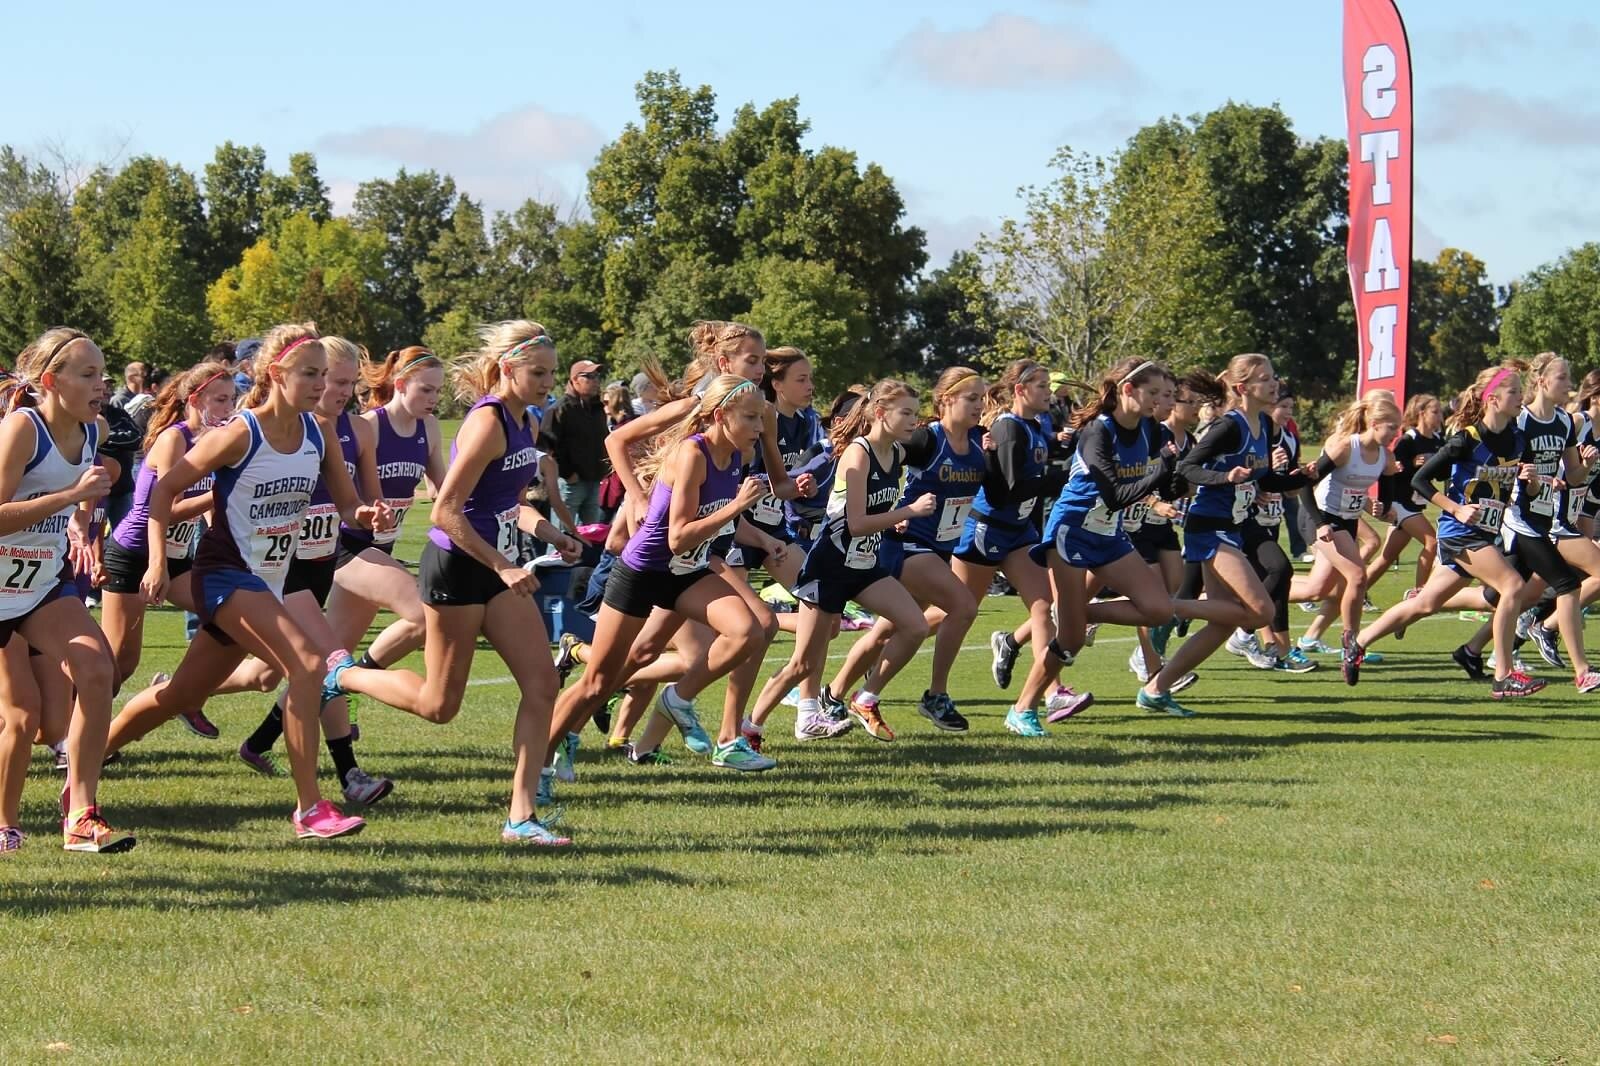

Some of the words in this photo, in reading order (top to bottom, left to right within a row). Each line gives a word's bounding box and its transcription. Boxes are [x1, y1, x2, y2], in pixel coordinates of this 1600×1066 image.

[1530, 435, 1566, 451] VALLEY
[939, 465, 982, 482] Christi
[1349, 495, 1363, 510] 25
[952, 505, 961, 525] 1
[299, 514, 333, 541] 301
[10, 547, 39, 559] McDonald
[265, 534, 292, 562] 29
[5, 558, 42, 589] 27
